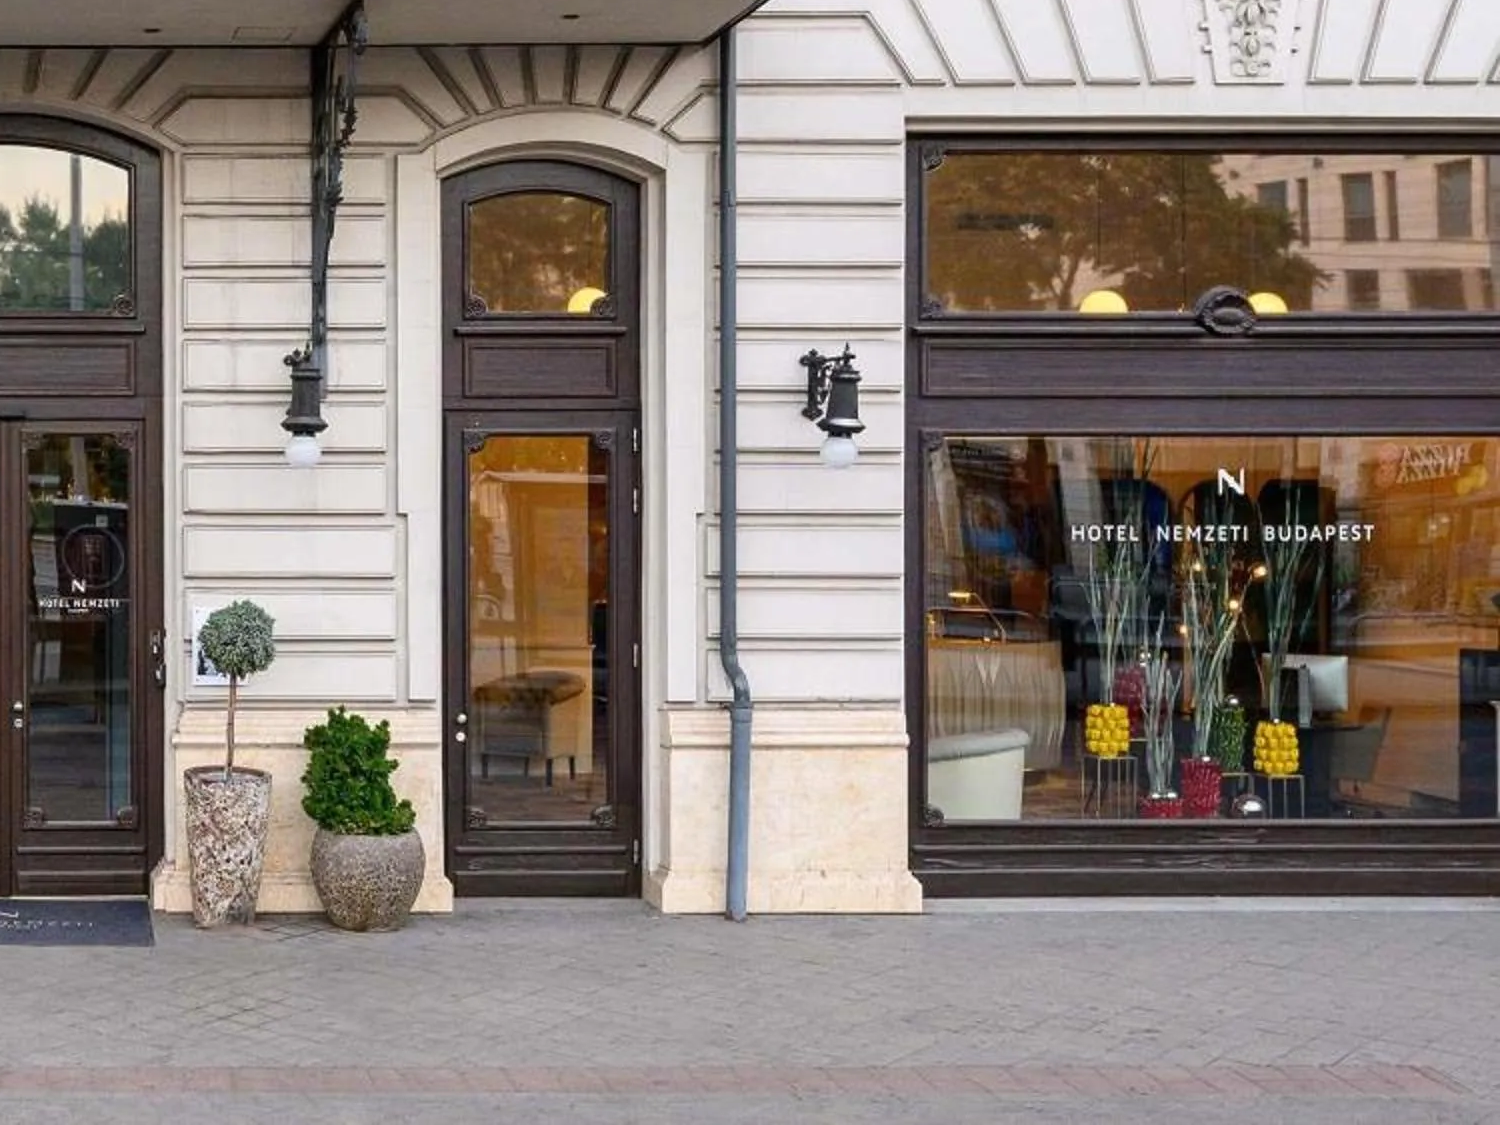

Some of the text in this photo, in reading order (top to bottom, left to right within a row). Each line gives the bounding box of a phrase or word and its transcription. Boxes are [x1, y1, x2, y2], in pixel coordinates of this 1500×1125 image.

[1218, 467, 1245, 495] N
[1071, 524, 1375, 542] HOTEL NEMZETI BUDAPEST
[71, 579, 86, 592] N
[39, 598, 120, 608] HOTEL NEMZETI
